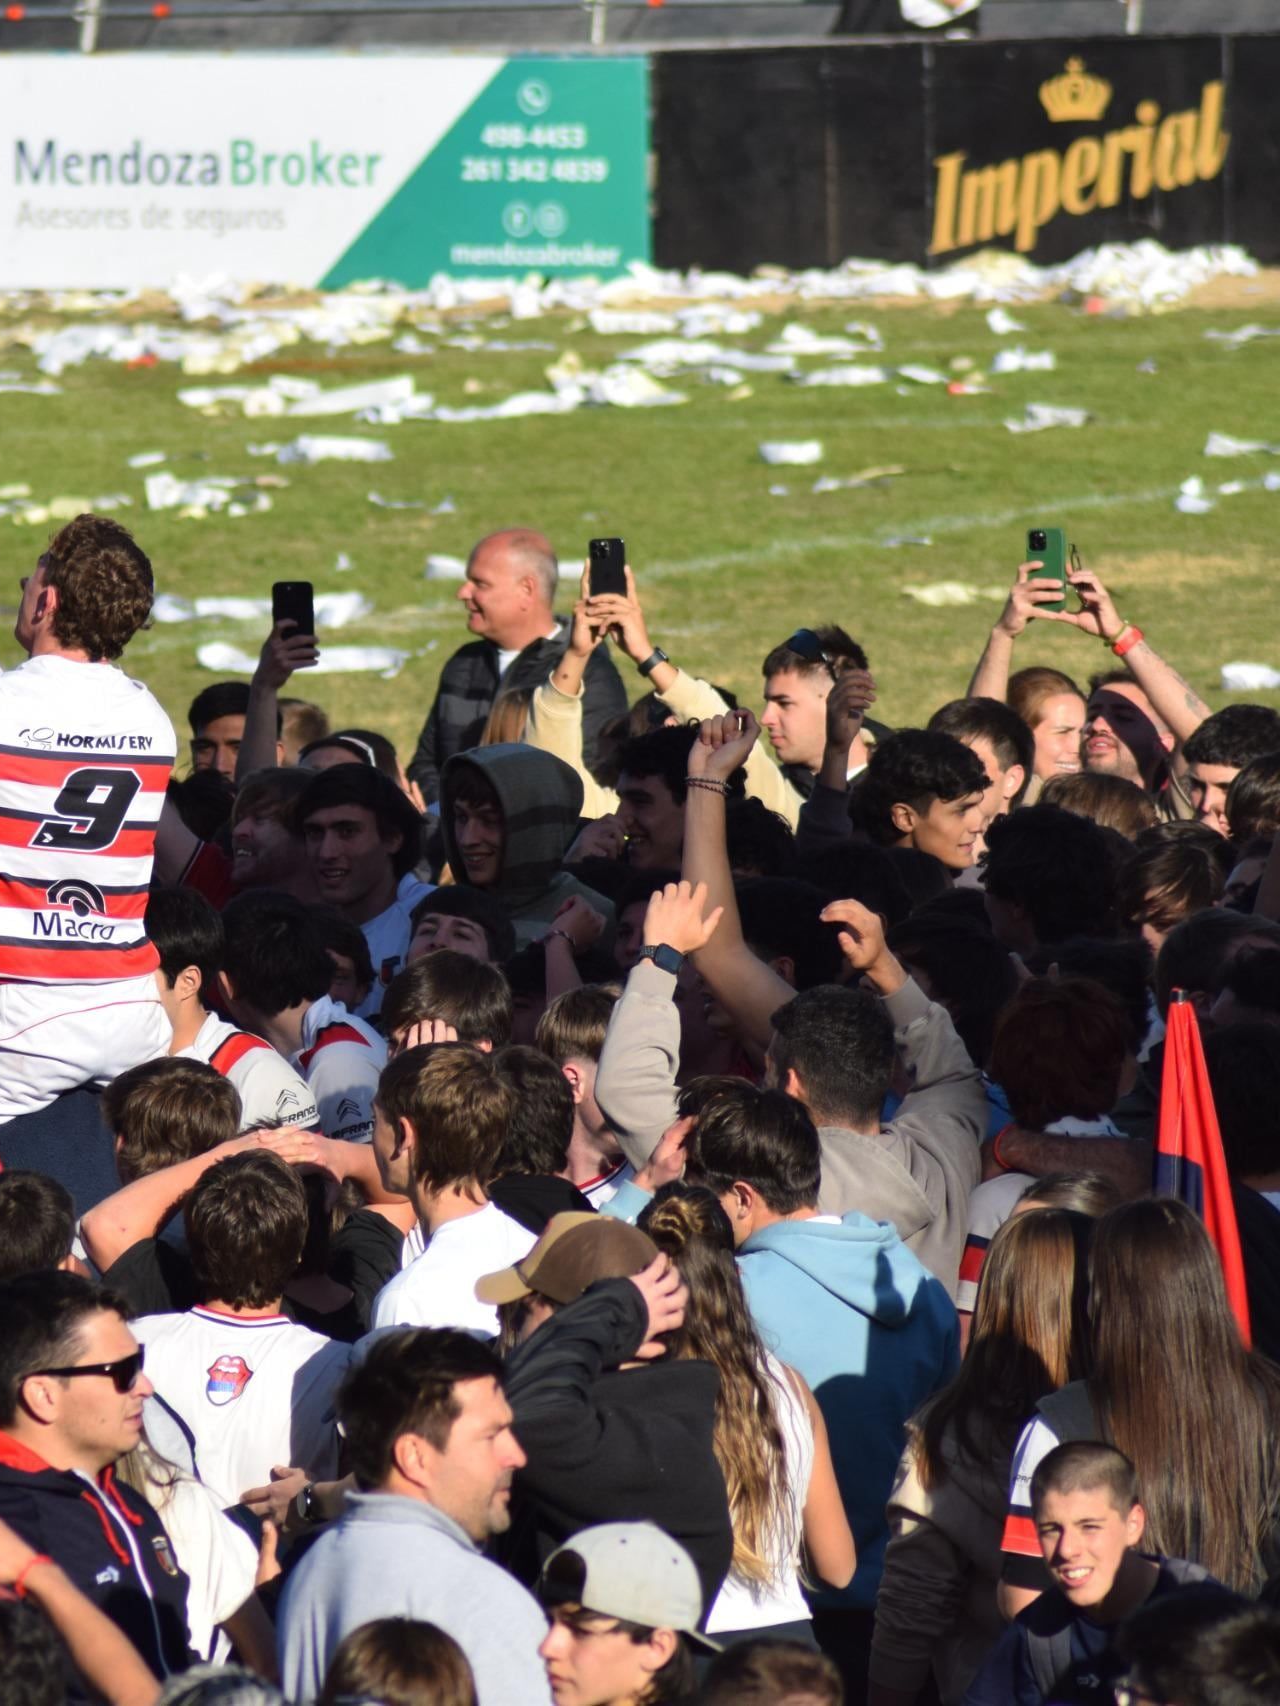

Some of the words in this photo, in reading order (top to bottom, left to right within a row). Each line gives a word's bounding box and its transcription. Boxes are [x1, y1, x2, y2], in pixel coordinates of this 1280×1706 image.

[927, 79, 1231, 257] Imperial
[16, 202, 131, 231] Asesores
[140, 202, 173, 231] de
[183, 208, 286, 237] seguros
[27, 766, 144, 853] 9
[32, 911, 116, 940] Macro
